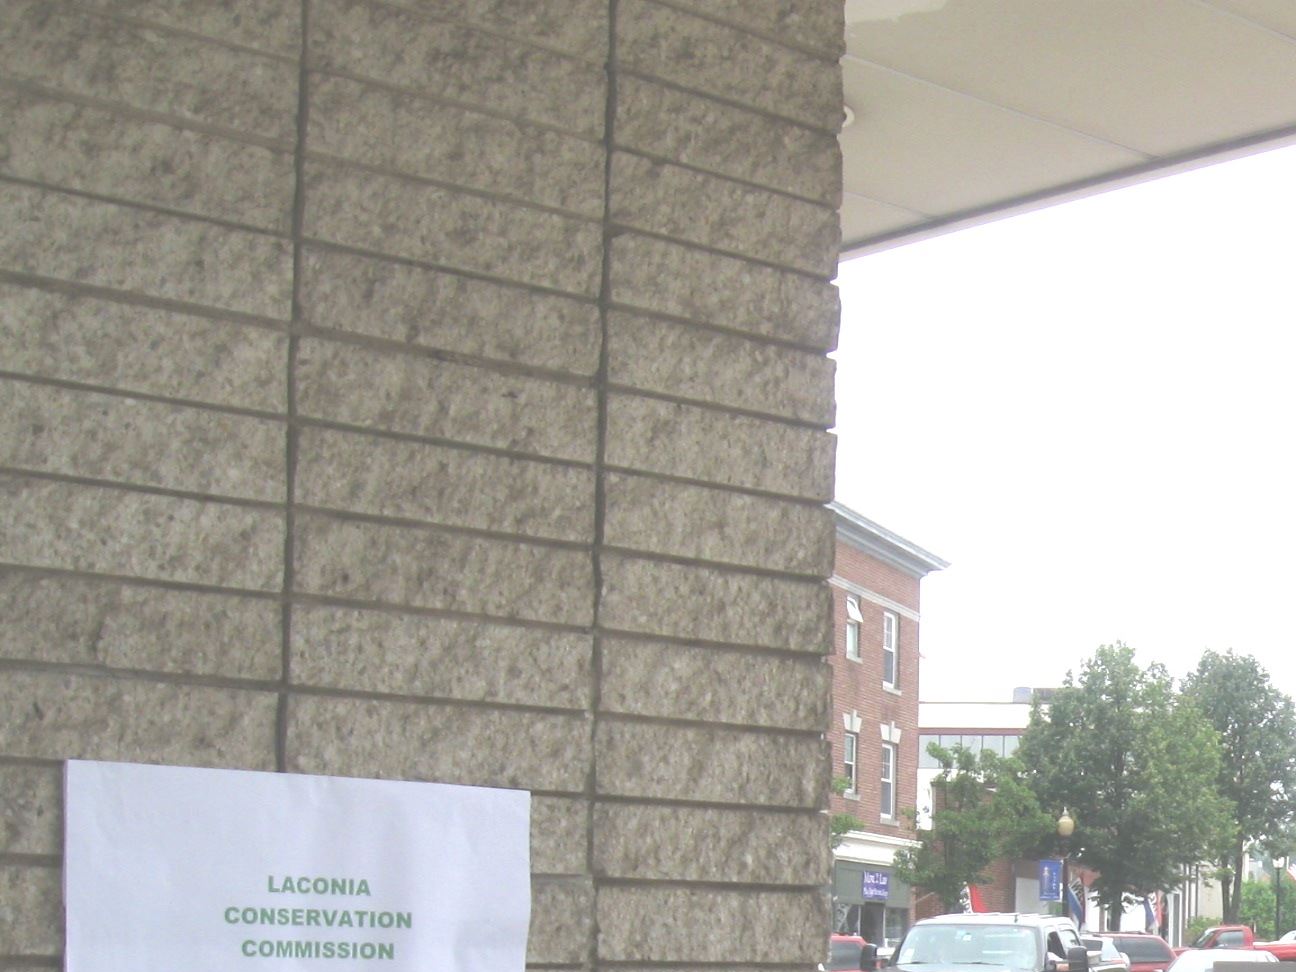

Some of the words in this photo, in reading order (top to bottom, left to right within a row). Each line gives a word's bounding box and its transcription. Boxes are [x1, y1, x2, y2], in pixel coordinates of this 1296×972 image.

[267, 875, 371, 896] LACONIA
[224, 906, 412, 929] CONSERVATION
[241, 939, 394, 960] COMMISSION
